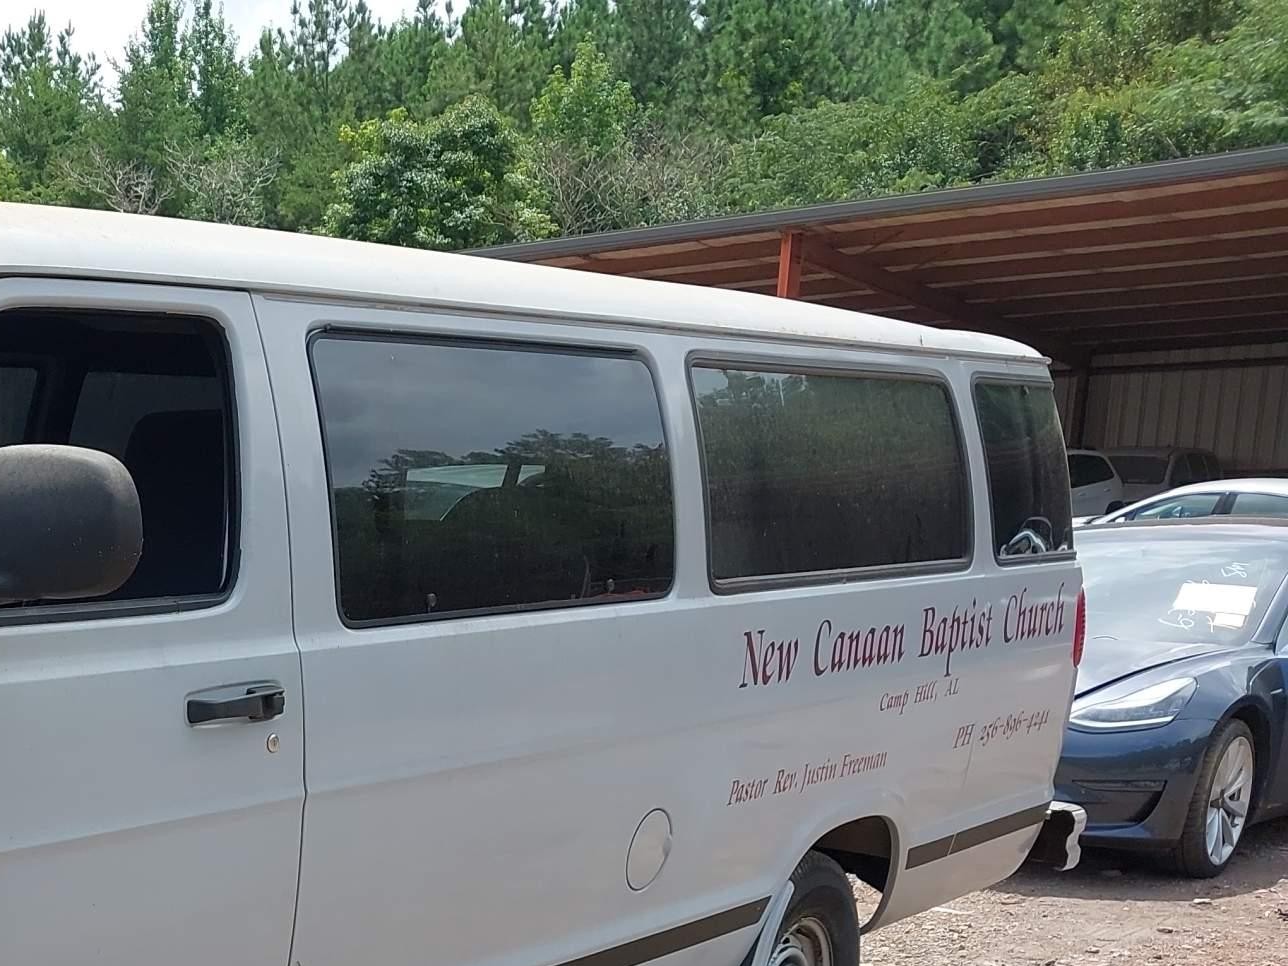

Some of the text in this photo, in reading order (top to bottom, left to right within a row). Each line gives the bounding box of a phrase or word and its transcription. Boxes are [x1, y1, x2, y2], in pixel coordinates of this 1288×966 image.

[738, 582, 1065, 689] New Canaan Baptist Church
[879, 678, 960, 715] Camp Hill, AL
[953, 724, 976, 749] PH
[726, 751, 888, 807] Pastor Rev. Justin Freeman
